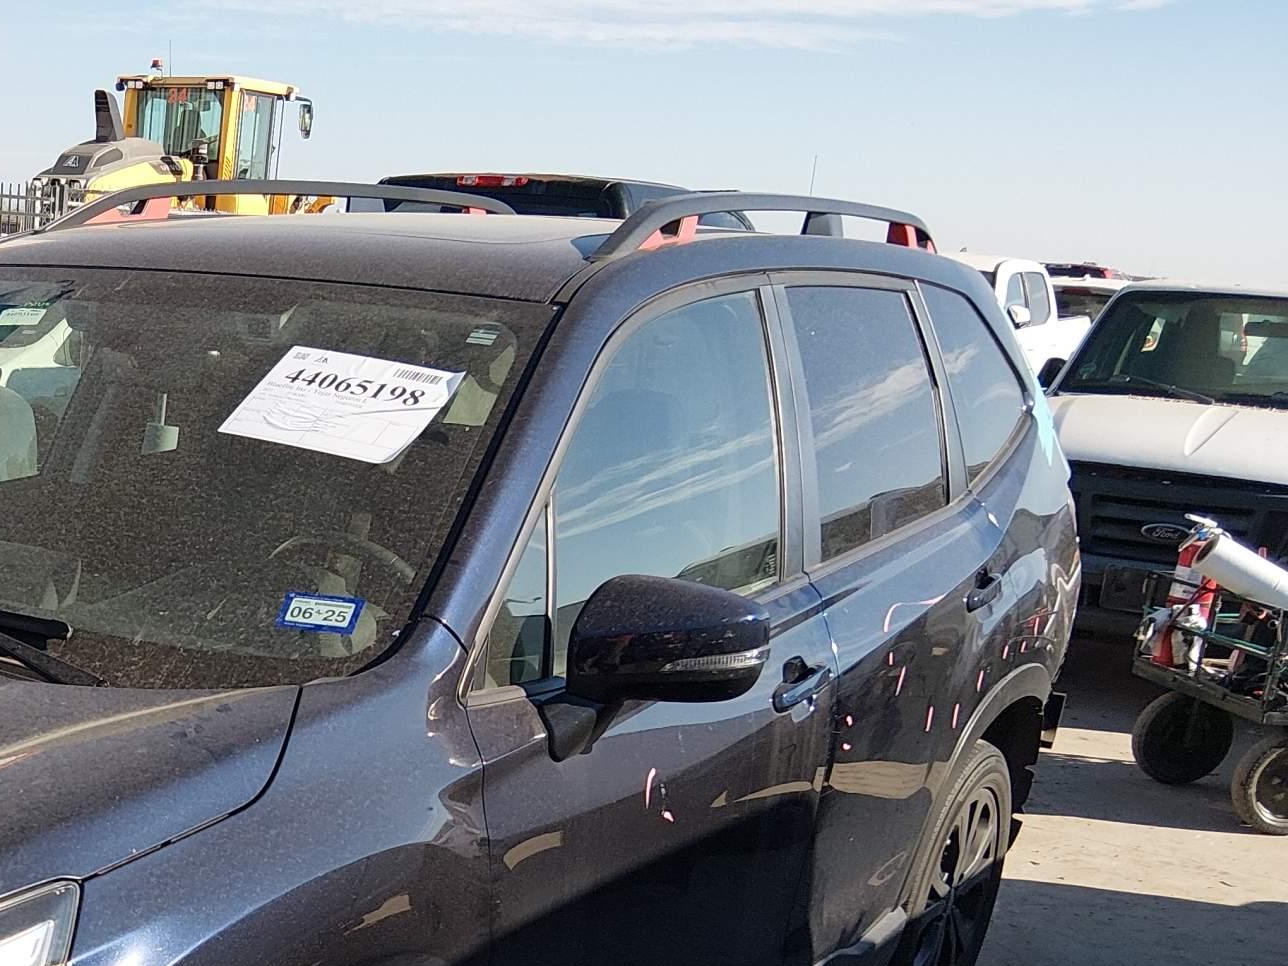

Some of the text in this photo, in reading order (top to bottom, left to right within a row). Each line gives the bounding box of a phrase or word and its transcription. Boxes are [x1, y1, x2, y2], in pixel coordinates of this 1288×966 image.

[285, 368, 426, 407] 44065198
[1152, 527, 1180, 540] Ford
[290, 606, 348, 622] 06 25
